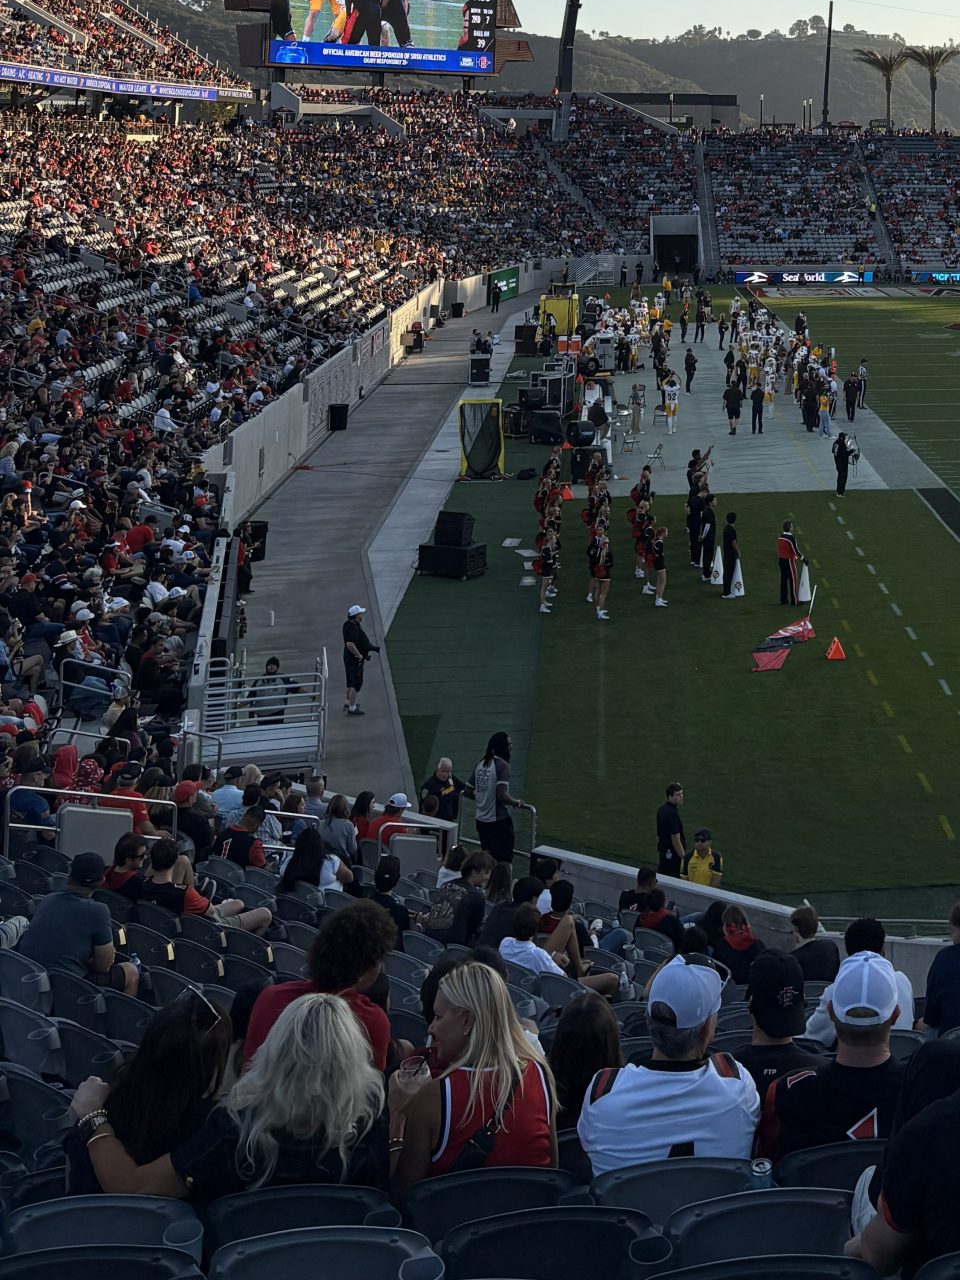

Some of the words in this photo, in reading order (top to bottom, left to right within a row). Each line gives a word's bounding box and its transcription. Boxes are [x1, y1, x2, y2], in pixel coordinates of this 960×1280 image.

[477, 39, 486, 48] 39
[322, 48, 344, 56] OFFICIAL
[2, 67, 16, 77] DRAINS
[28, 70, 44, 81] HEATING
[67, 77, 78, 85] WATER
[85, 78, 97, 88] BROKEN
[119, 82, 133, 91] WATER
[134, 84, 147, 92] LEAKS
